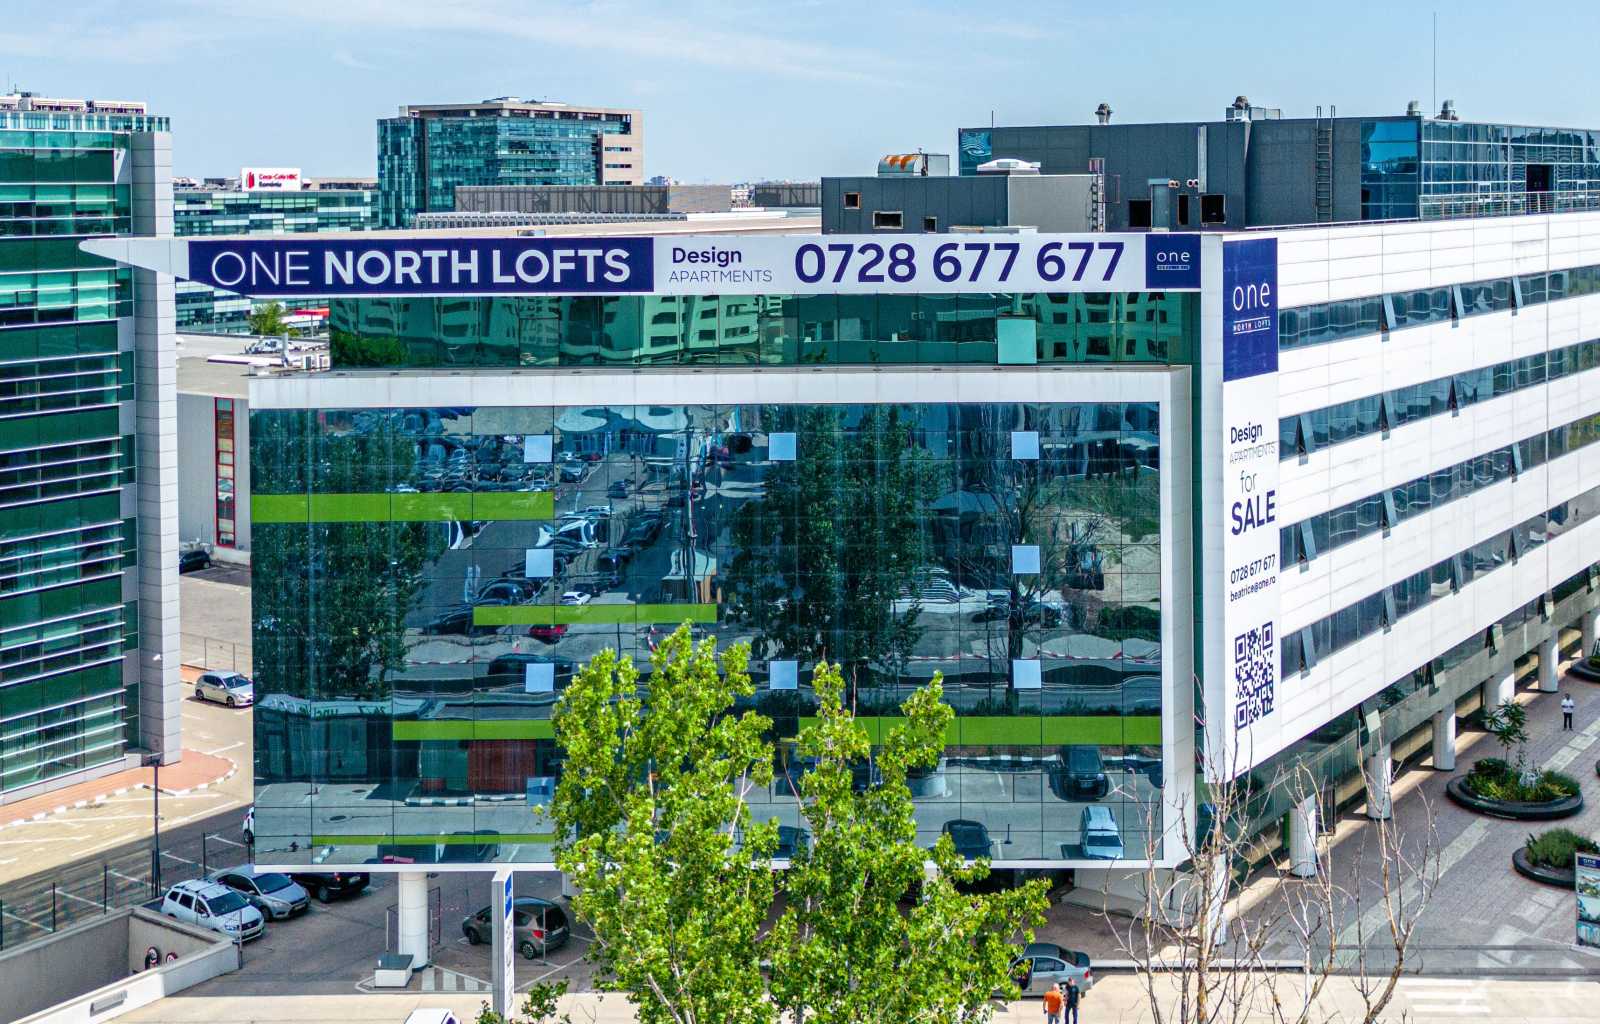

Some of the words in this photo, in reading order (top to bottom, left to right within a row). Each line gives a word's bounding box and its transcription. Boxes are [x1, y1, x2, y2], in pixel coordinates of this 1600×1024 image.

[211, 251, 310, 286] ONE
[324, 250, 479, 285] NORTH
[492, 248, 631, 283] LOFTS
[672, 245, 742, 268] Design
[795, 243, 917, 283] 0728
[932, 242, 1020, 282] 677
[1036, 242, 1125, 282] 677
[1156, 251, 1191, 262] one
[668, 269, 773, 283] APARTMENTS
[1232, 282, 1271, 312] one
[1233, 322, 1252, 332] NORTH
[1254, 318, 1271, 329] LOFTS
[1230, 421, 1263, 445] Design
[1230, 443, 1276, 464] APARTMENTS
[1240, 469, 1258, 494] for
[1231, 490, 1276, 536] SALE
[1230, 564, 1248, 585] 0728
[1249, 559, 1262, 577] 677
[1263, 553, 1276, 571] 677
